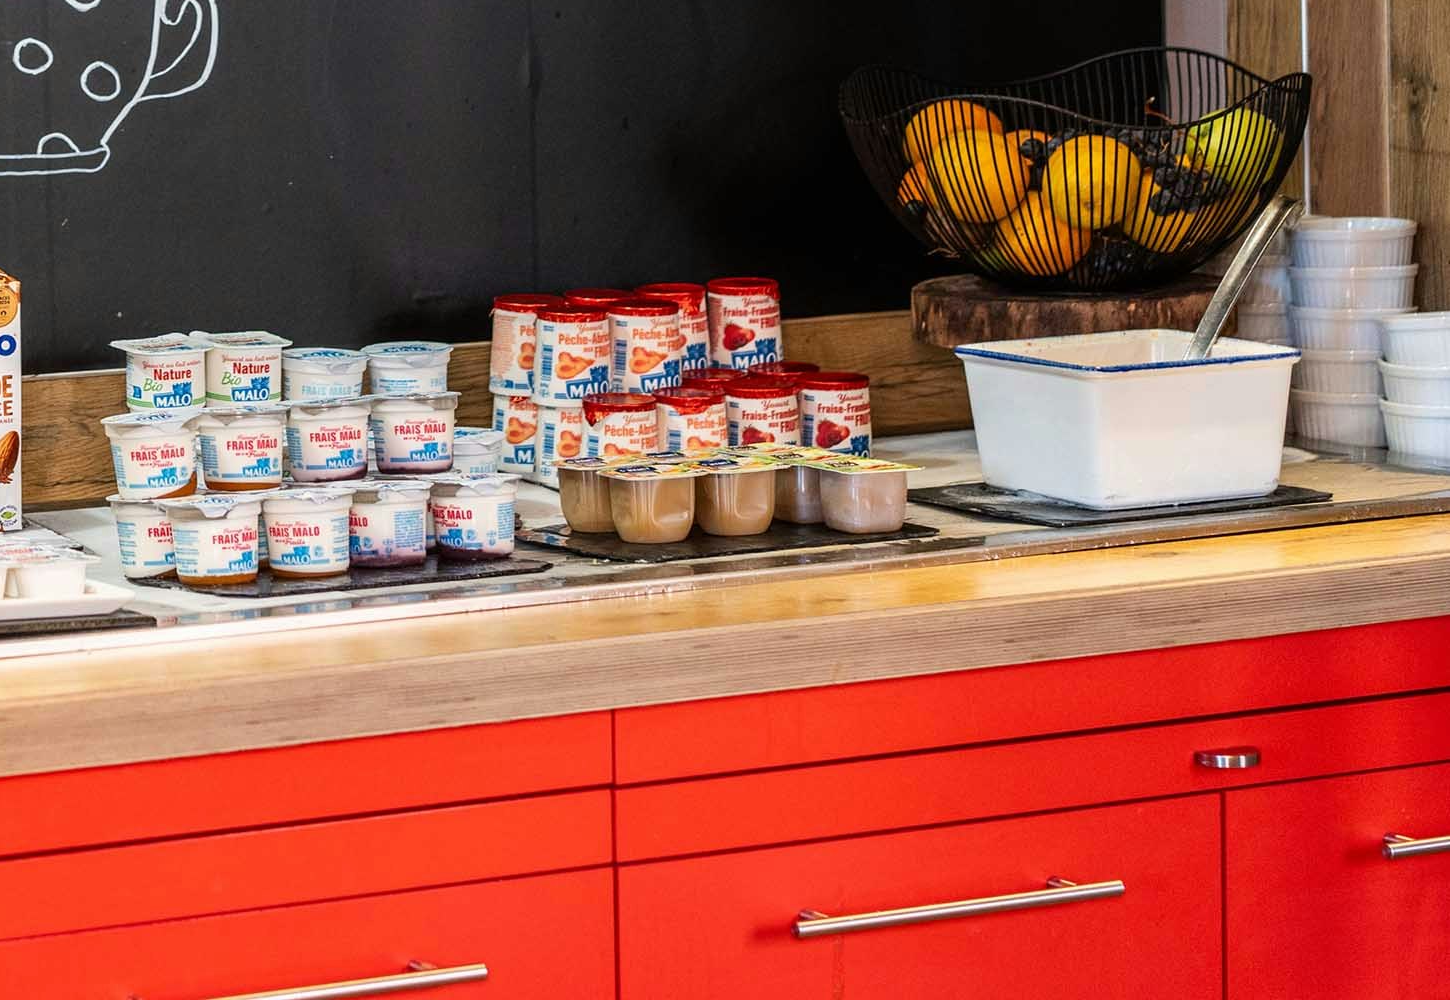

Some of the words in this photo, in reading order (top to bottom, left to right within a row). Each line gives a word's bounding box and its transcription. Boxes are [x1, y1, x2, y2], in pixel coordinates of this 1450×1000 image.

[682, 356, 708, 370] ALO
[734, 352, 777, 371] MALO
[153, 369, 192, 381] Nature
[232, 362, 270, 375] Nature
[143, 377, 163, 392] Bio
[221, 371, 242, 385] Bio
[644, 375, 680, 393] MALO
[234, 388, 269, 401] MALO
[570, 380, 609, 399] MALO
[156, 393, 192, 407] MALO
[310, 431, 337, 442] FRAIS
[340, 429, 362, 441] MALO
[394, 424, 421, 436] FRAIS
[424, 423, 446, 434] MALO
[226, 440, 254, 451] FRAIS
[256, 438, 278, 450] MALO
[130, 450, 158, 462] FRAIS
[160, 447, 185, 460] MALO
[412, 451, 438, 461] MALO
[328, 458, 354, 468] MALO
[244, 466, 270, 477] MALO
[148, 475, 178, 487] MALO
[446, 508, 472, 520] MALO
[269, 526, 290, 538] FRAIS
[292, 526, 320, 537] MALO
[212, 534, 240, 545] FRAIS
[232, 560, 254, 572] MALO
[282, 554, 310, 565] MALO
